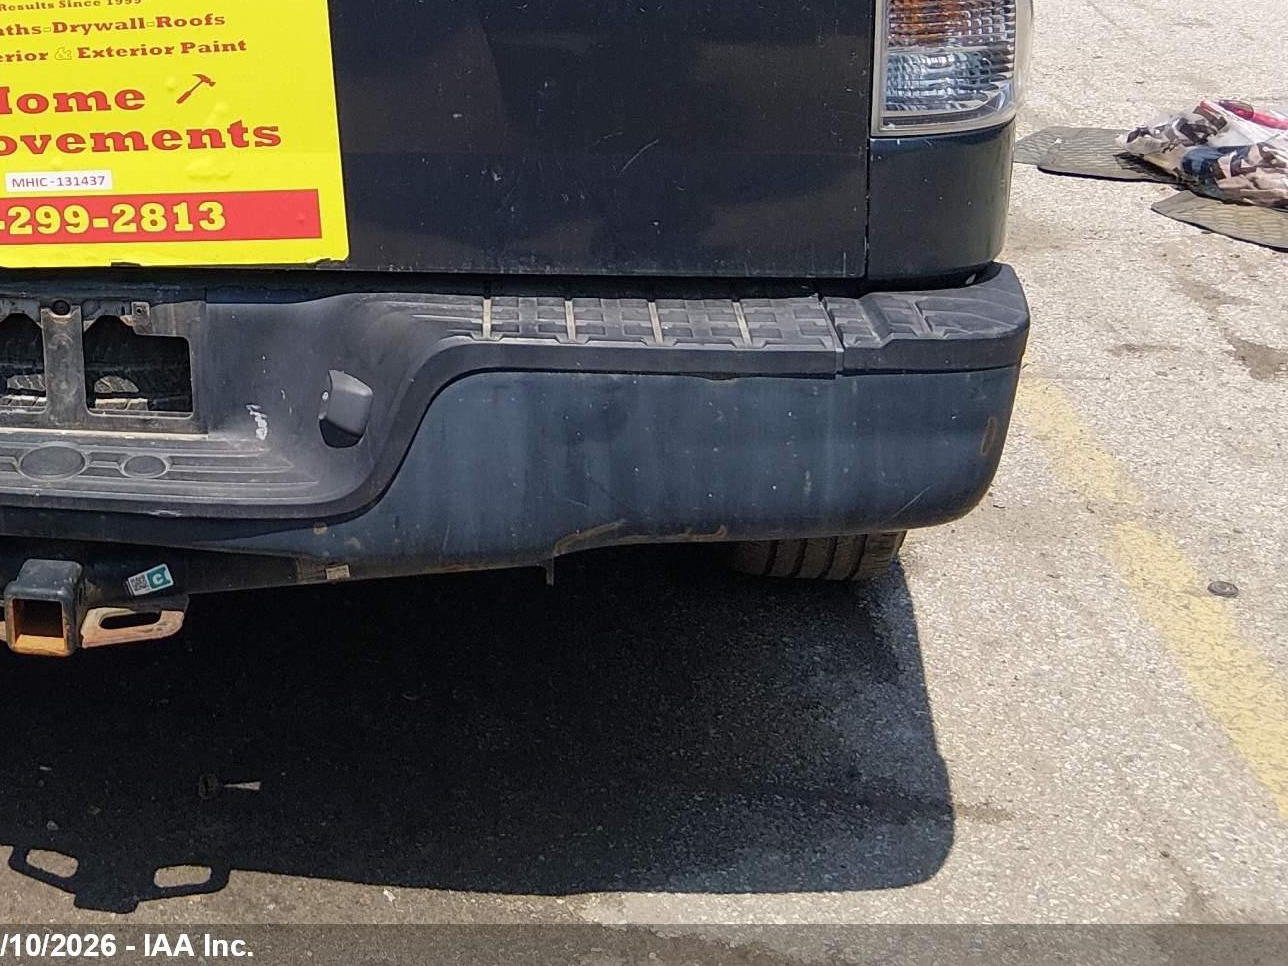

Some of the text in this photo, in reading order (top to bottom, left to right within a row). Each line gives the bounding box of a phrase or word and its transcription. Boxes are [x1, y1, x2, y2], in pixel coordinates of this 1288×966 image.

[54, 47, 73, 61] &
[77, 43, 175, 60] Exterior
[180, 39, 248, 55] Paint
[11, 175, 107, 190] MHIC-131437
